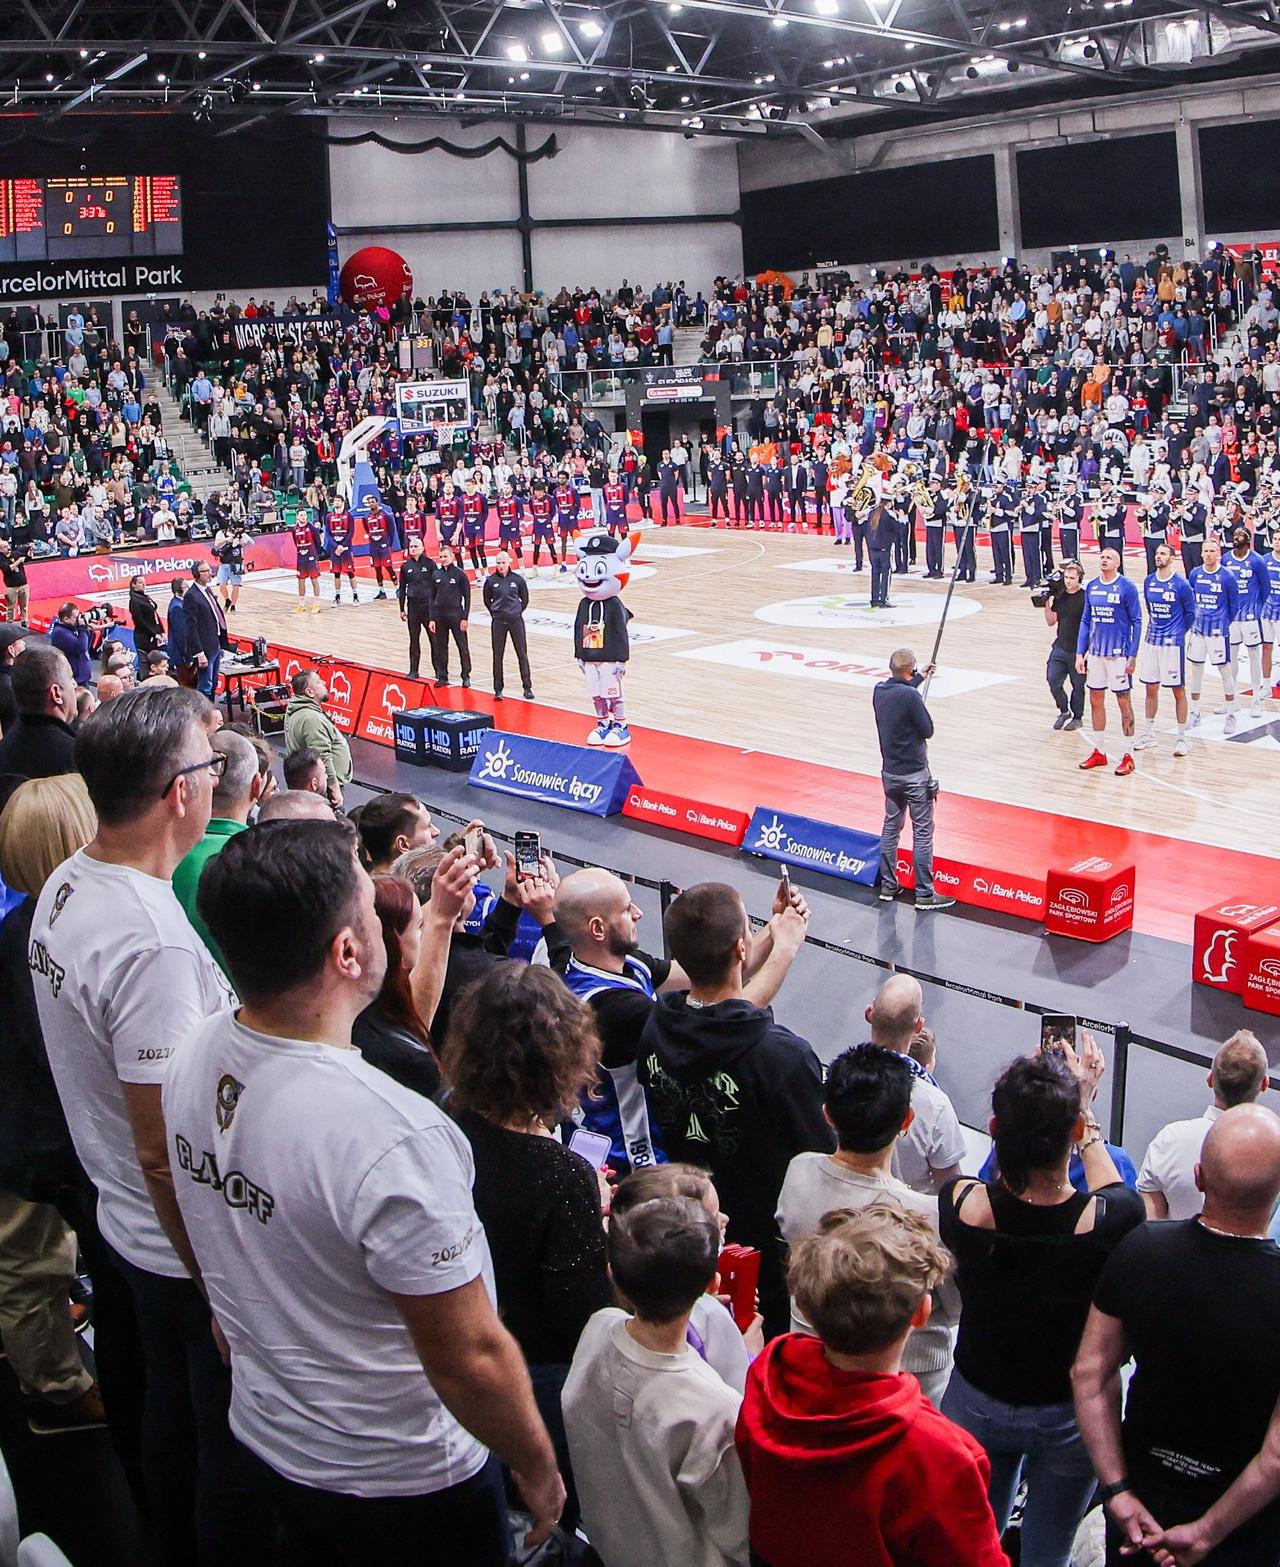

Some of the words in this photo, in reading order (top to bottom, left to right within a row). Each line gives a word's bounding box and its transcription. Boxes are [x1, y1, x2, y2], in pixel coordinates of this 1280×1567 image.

[65, 191, 73, 203] 0
[105, 190, 113, 202] 0
[64, 223, 72, 234] 0
[106, 221, 115, 233] 0
[135, 265, 183, 286] Park
[416, 388, 458, 398] SUZUKI
[120, 560, 153, 577] Bank
[155, 557, 194, 572] Pekao
[460, 745, 481, 755] RATI
[511, 763, 569, 793] Sosnowiec
[568, 775, 603, 804] łączy
[642, 799, 659, 811] Bank
[658, 803, 677, 816] Pekao
[700, 814, 717, 827] Bank
[717, 819, 737, 832] Pekao
[784, 837, 837, 865] Sosnowiec
[836, 850, 866, 876] łączy
[934, 870, 960, 886] Pekao
[992, 884, 1015, 899] Bank
[1015, 889, 1043, 906] Pekao
[1049, 901, 1098, 917] ZAGŁĘBIOWSKI
[1064, 912, 1097, 925] SPORTOWY
[1247, 981, 1264, 992] PARK
[1081, 1019, 1115, 1034] ArcelorM
[630, 1137, 657, 1169] 198
